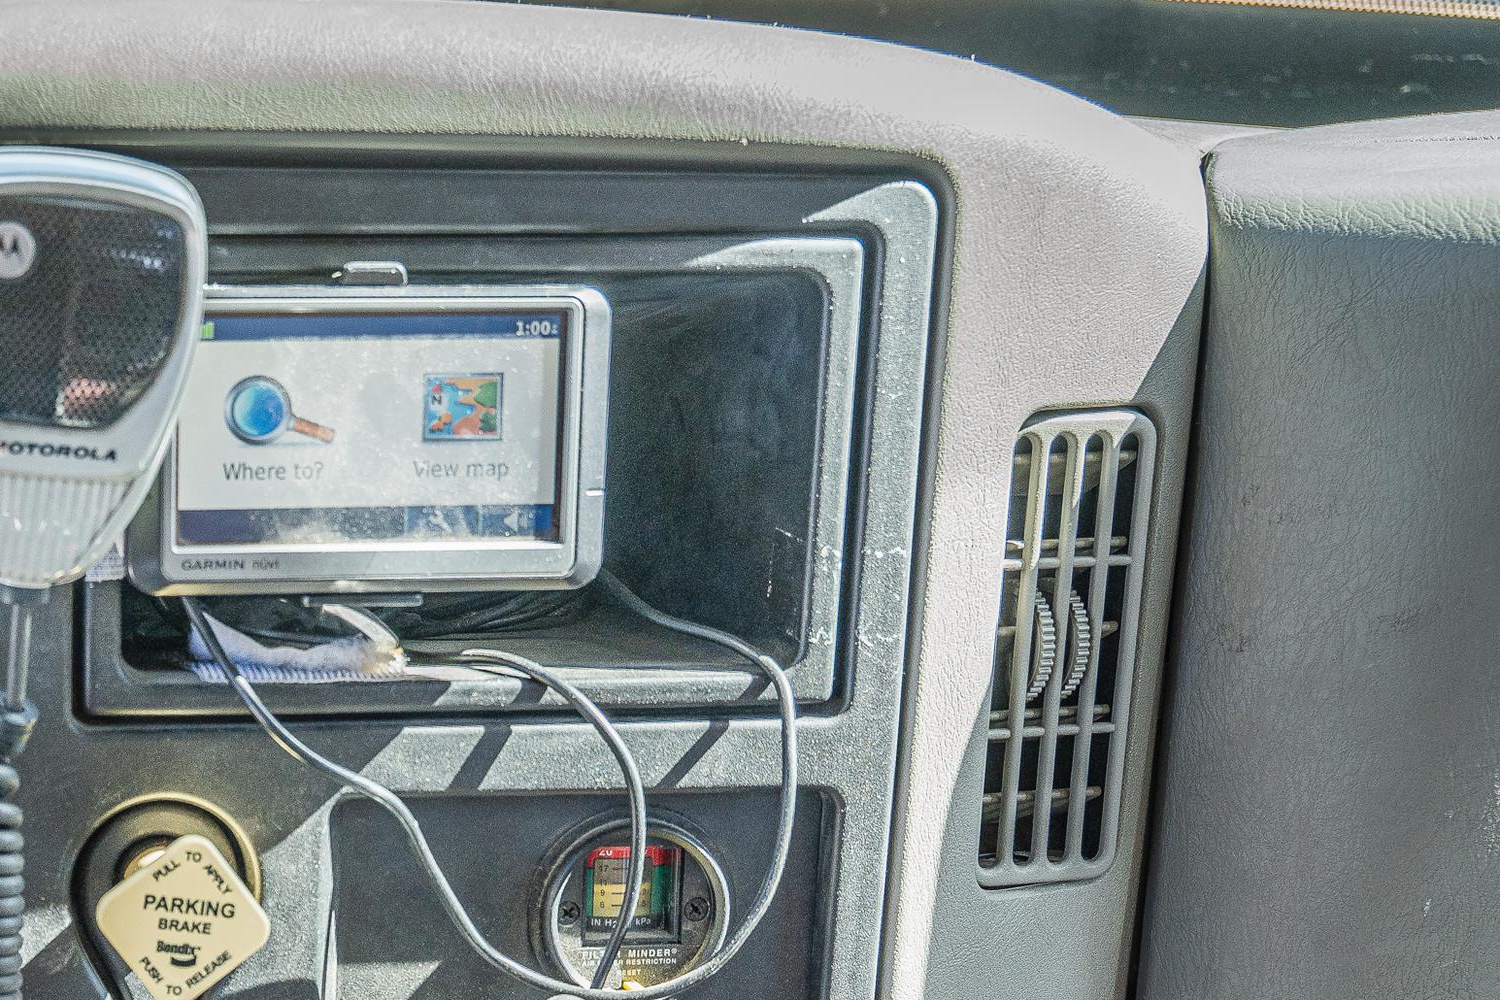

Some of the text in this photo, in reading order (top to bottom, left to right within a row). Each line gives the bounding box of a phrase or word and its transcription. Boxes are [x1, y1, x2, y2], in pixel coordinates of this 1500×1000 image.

[516, 320, 551, 336] 1:00
[222, 460, 324, 481] Where to?
[414, 461, 510, 480] View map
[181, 560, 245, 571] GARMIN
[152, 851, 233, 895] PULL TO APPLY
[143, 895, 235, 918] PARKING
[158, 918, 212, 935] BRAKE
[591, 918, 601, 926] IN
[626, 958, 677, 966] RESTRICTION
[140, 950, 232, 996] PUSH TO RELEASE
